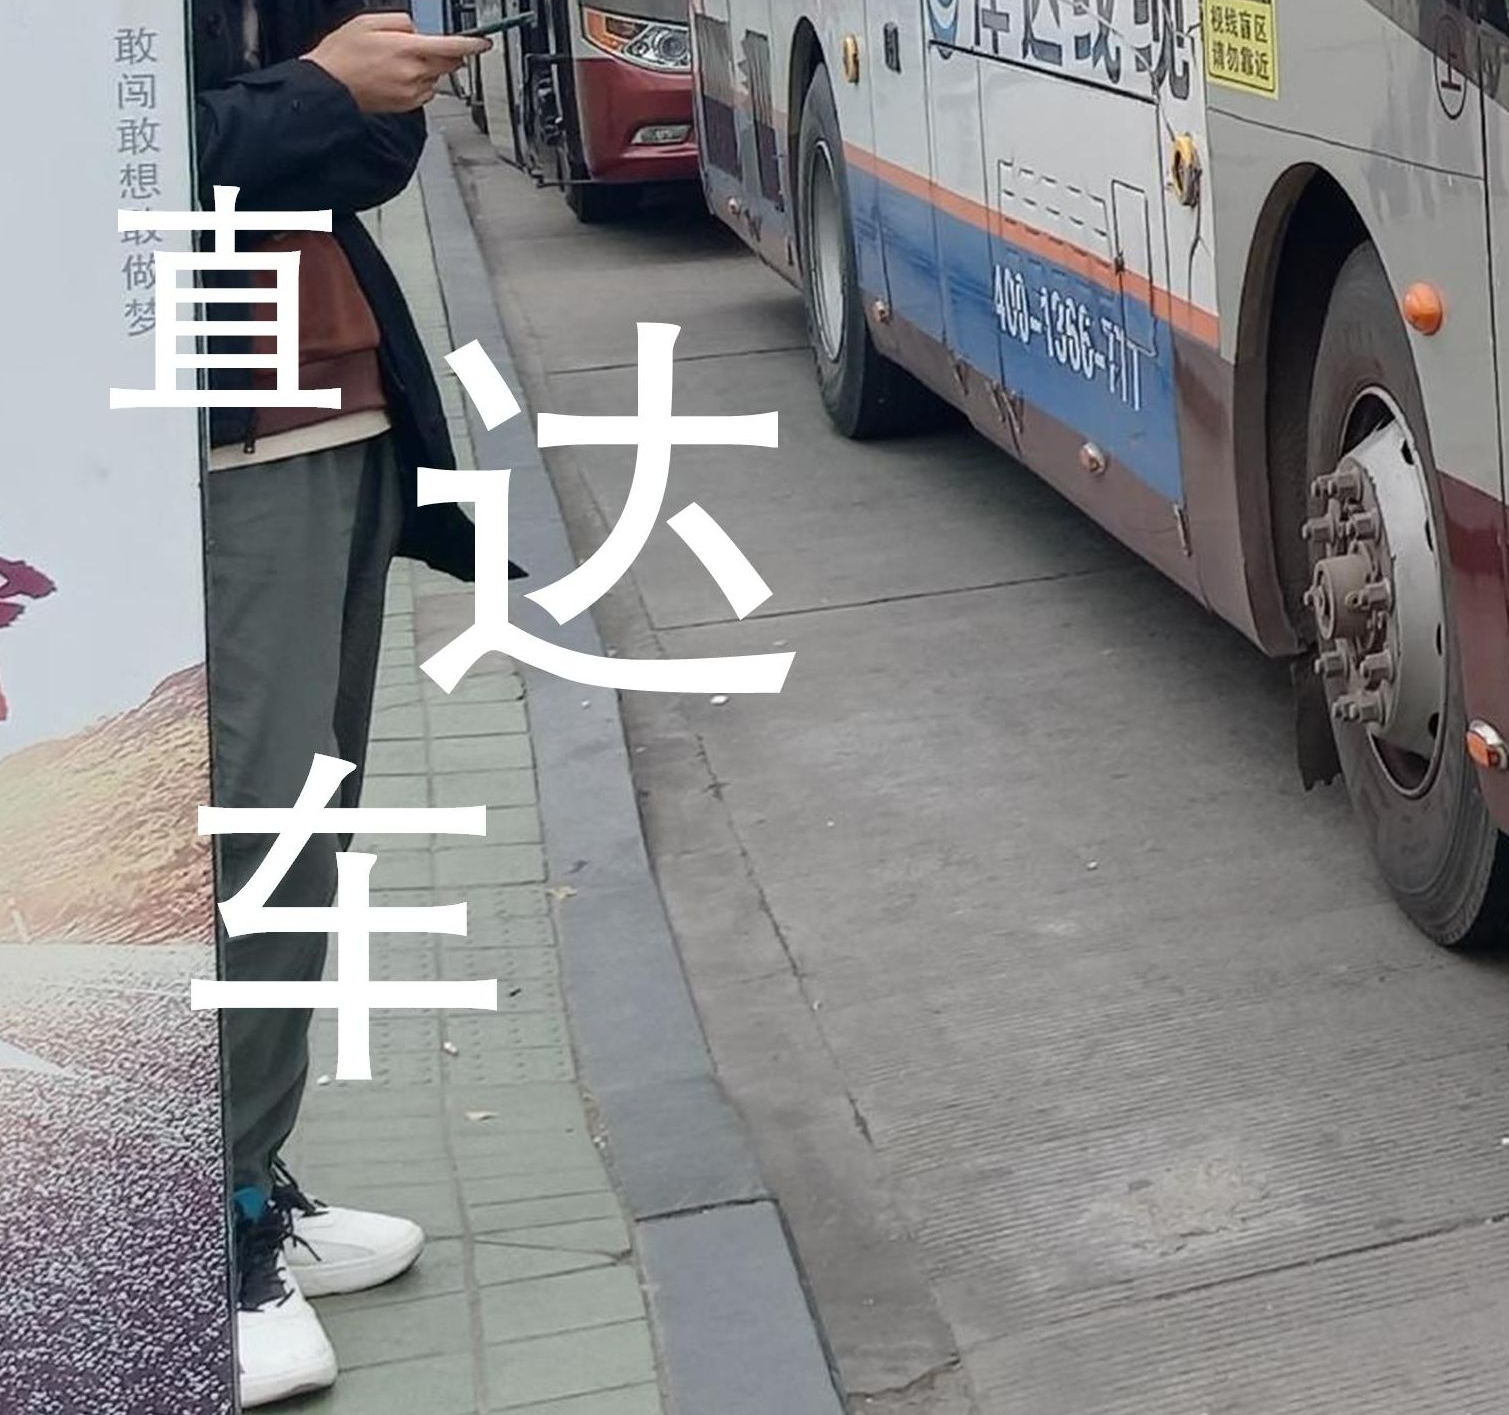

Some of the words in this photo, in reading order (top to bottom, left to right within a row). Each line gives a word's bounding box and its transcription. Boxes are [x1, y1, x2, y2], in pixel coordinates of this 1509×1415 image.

[1210, 4, 1268, 44] 视线盲区
[1211, 39, 1270, 81] 请勿靠近
